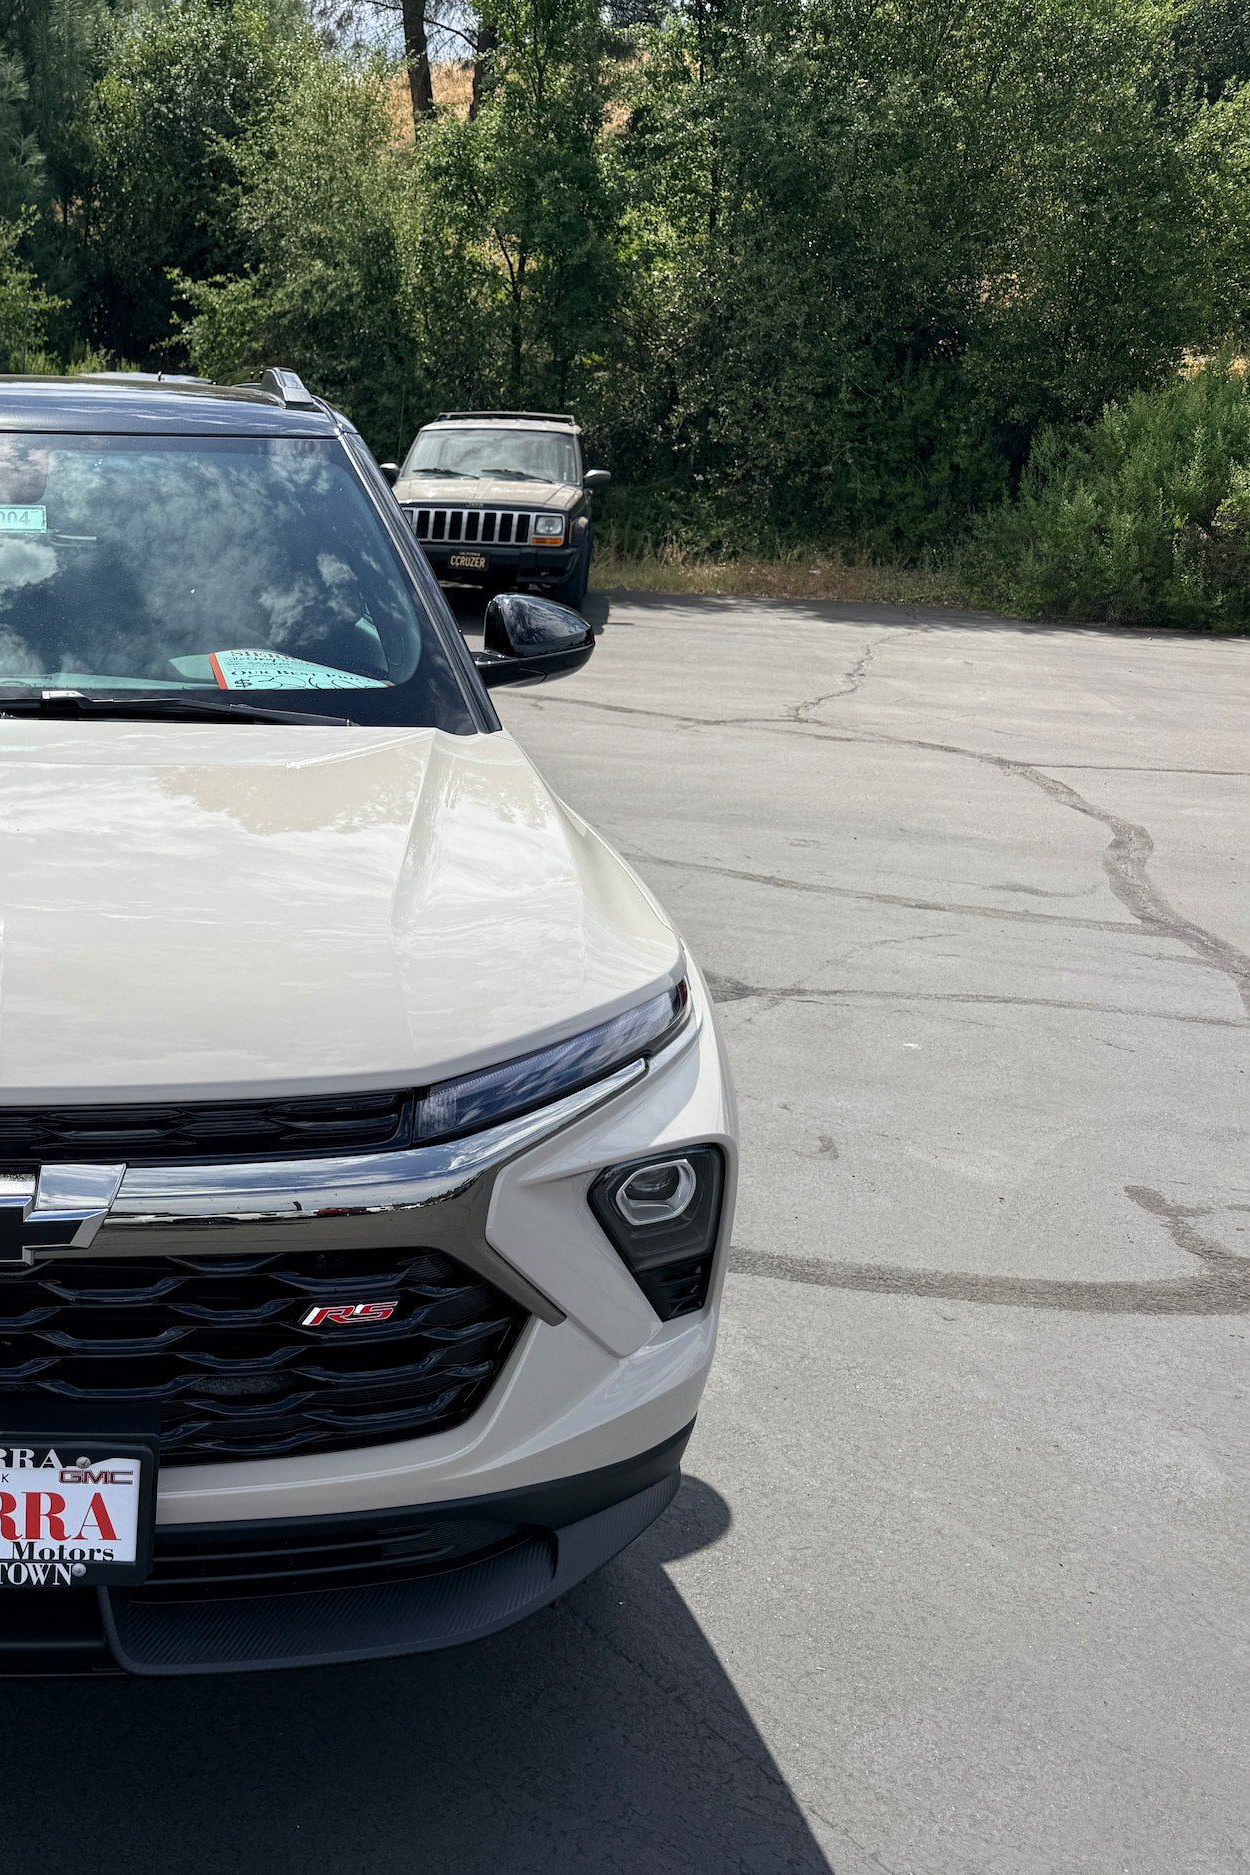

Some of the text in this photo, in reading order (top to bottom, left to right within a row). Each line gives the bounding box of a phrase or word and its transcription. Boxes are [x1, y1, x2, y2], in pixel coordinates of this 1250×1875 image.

[450, 555, 486, 569] CCRUZER
[301, 1300, 399, 1327] RS
[58, 1470, 134, 1486] GMC
[11, 1541, 115, 1563] Motors
